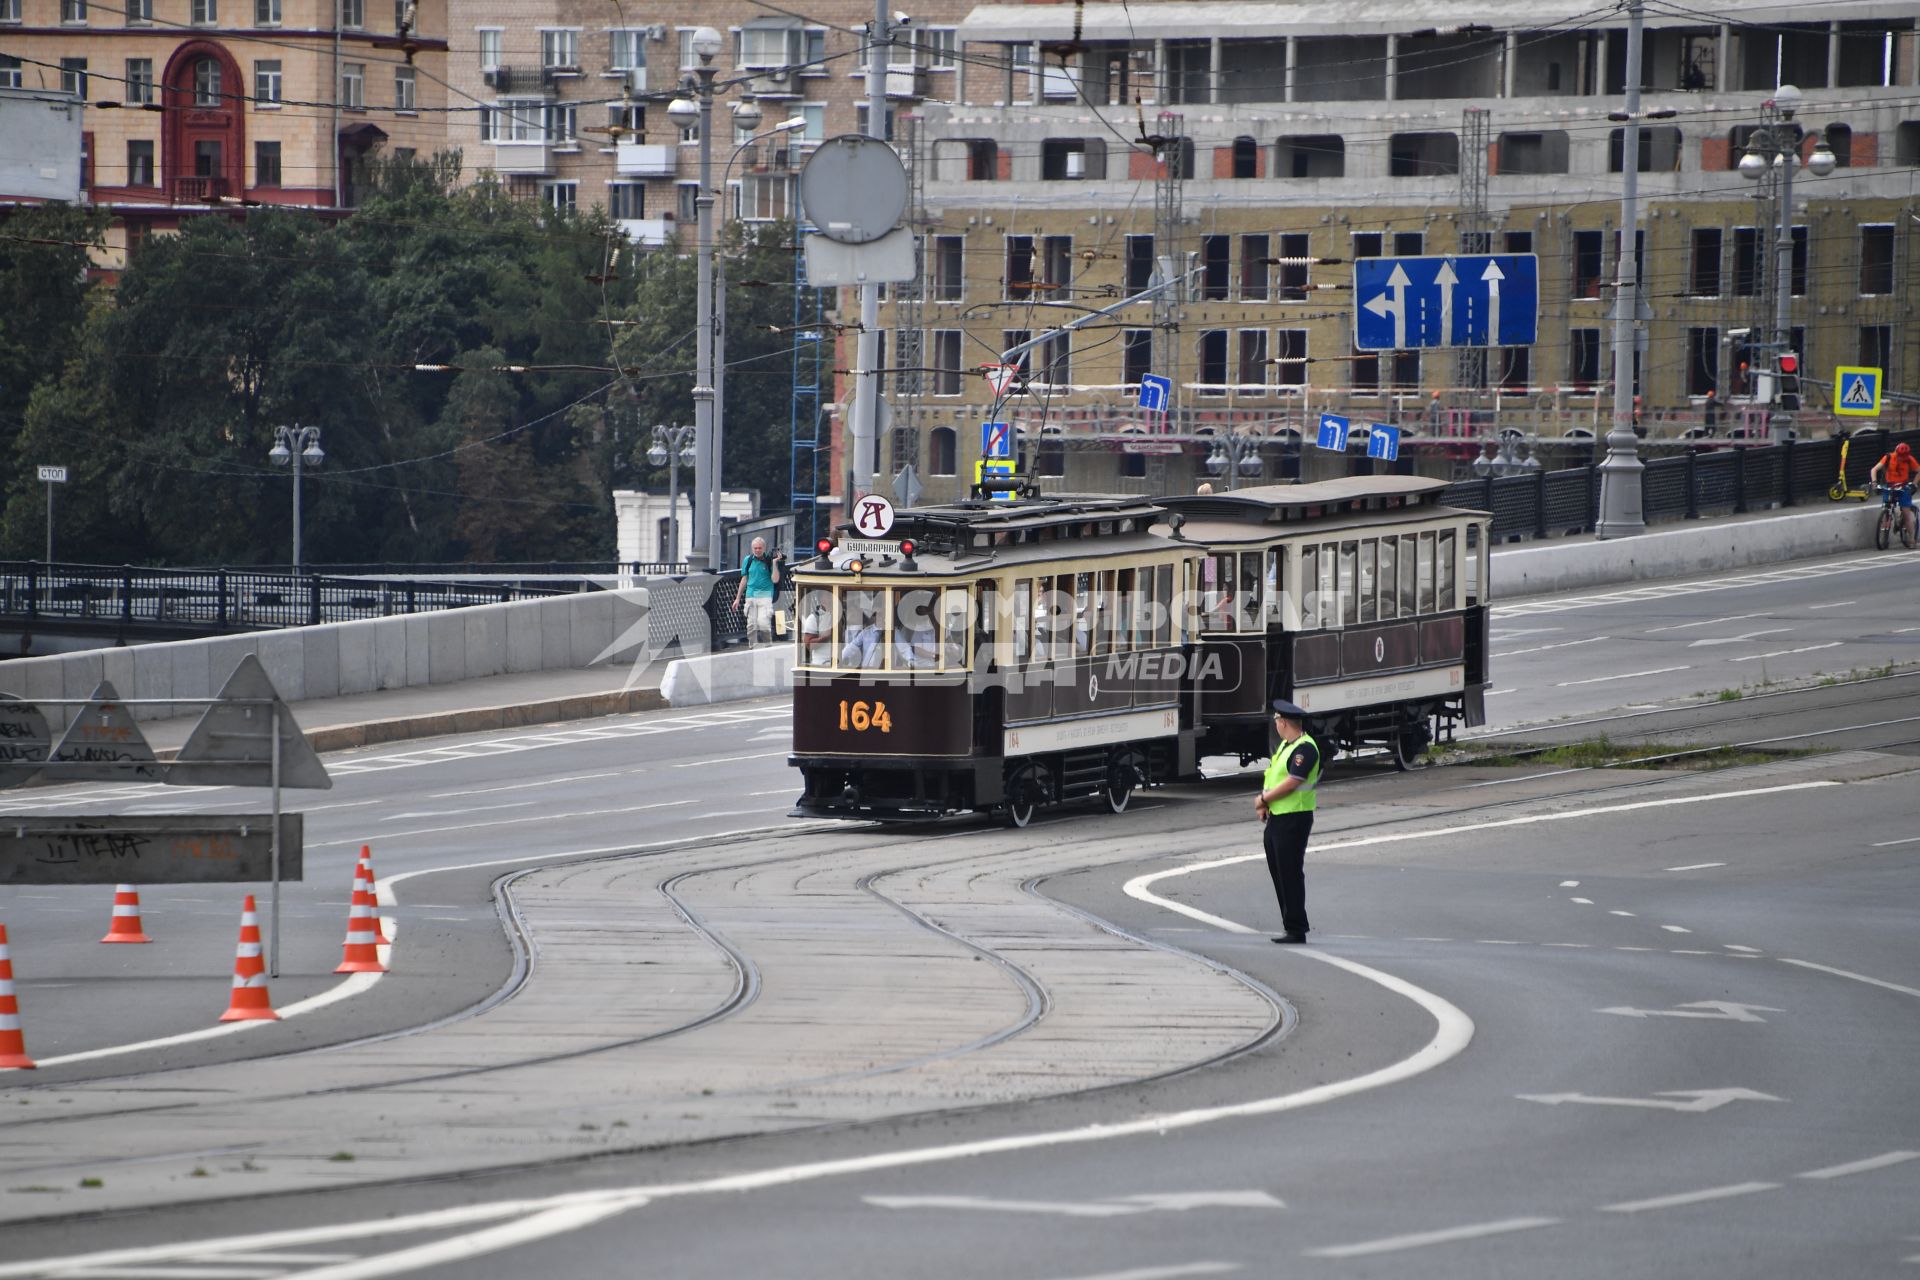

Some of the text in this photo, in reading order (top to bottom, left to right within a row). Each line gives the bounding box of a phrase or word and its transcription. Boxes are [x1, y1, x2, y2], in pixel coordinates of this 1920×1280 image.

[41, 468, 63, 479] СТОП
[860, 501, 886, 530] А
[839, 700, 892, 733] 164
[1164, 711, 1175, 729] 164
[1008, 731, 1020, 749] 164
